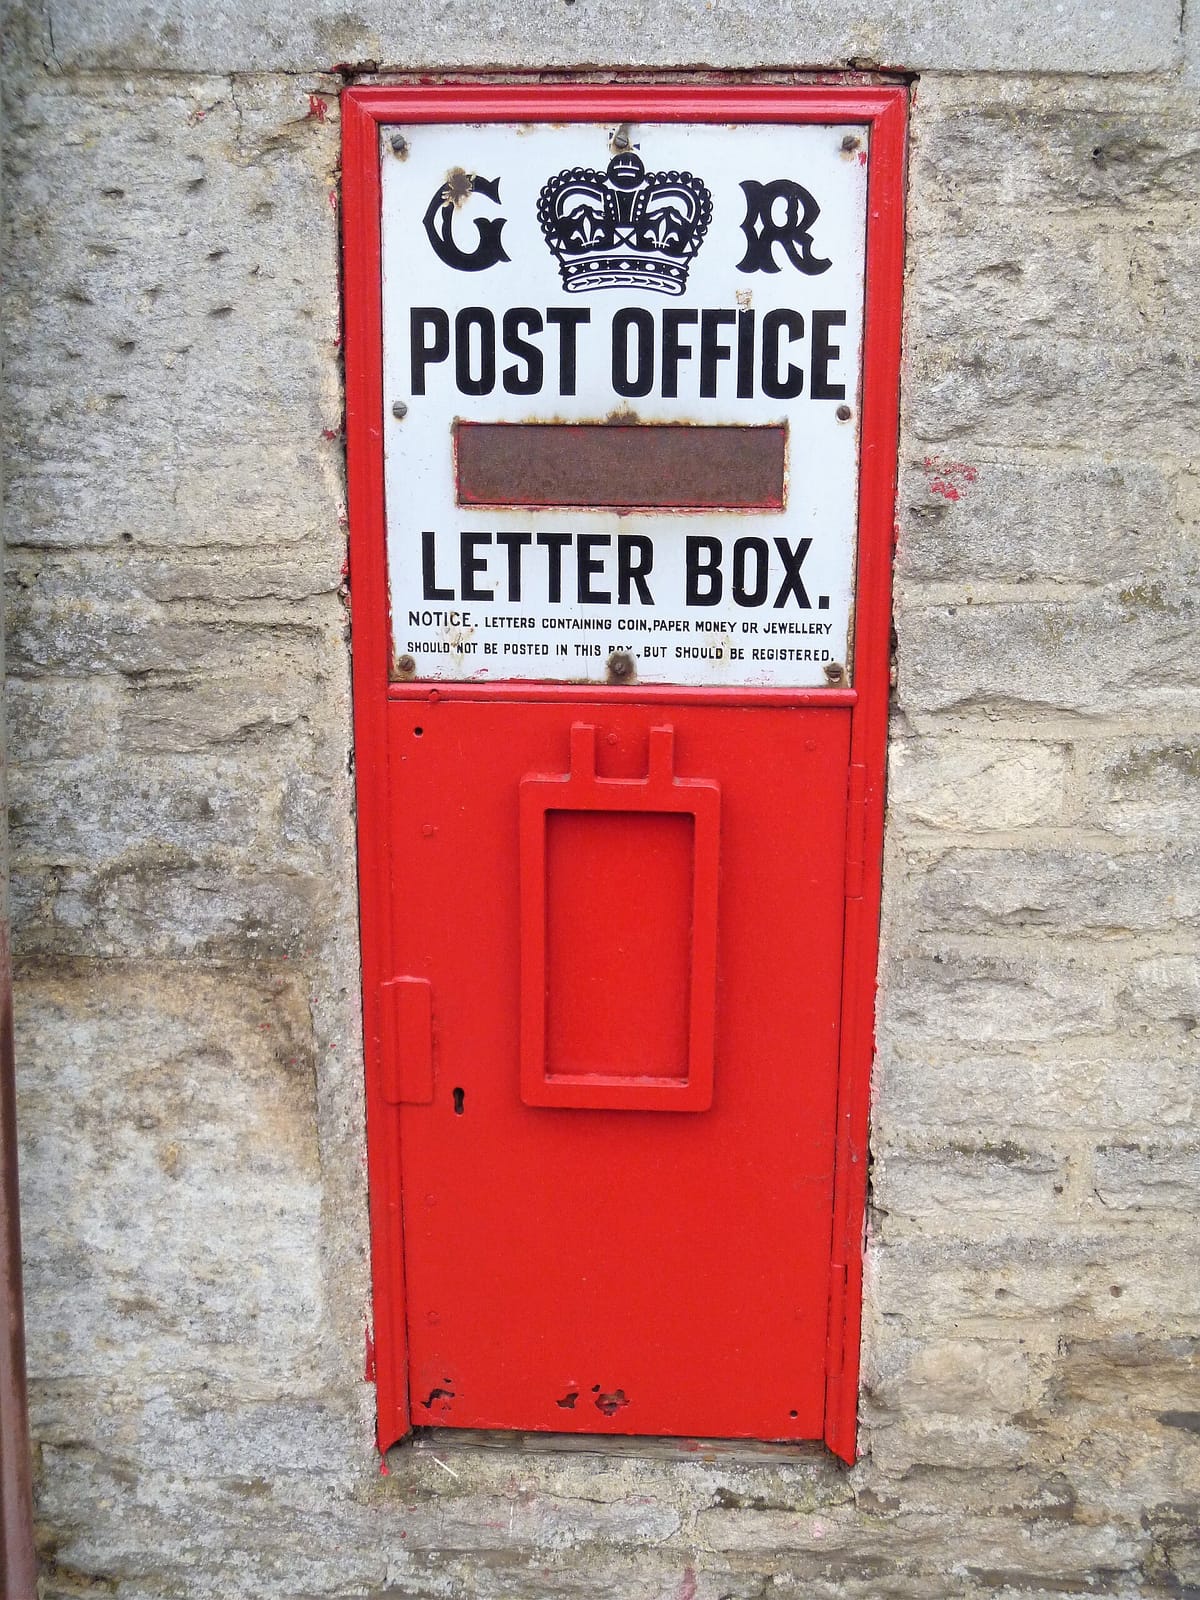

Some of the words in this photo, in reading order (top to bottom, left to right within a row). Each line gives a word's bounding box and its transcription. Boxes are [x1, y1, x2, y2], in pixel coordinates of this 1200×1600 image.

[423, 174, 511, 272] G
[736, 179, 832, 276] R
[411, 307, 590, 396] POST
[611, 308, 847, 400] OFFICE
[422, 532, 655, 605] LETTER
[685, 536, 829, 609] BOX.
[407, 642, 450, 653] SHOULD
[457, 642, 478, 654] NOT
[484, 643, 498, 654] BE
[504, 644, 548, 655] POSTED
[556, 644, 568, 656] IN
[574, 644, 601, 656] THIS
[675, 647, 723, 659] SHOULD
[730, 648, 745, 660] BE
[752, 648, 834, 661] REGISTERED.
[409, 611, 478, 627] NOTICE.
[485, 617, 535, 629] LETTERS
[542, 618, 612, 630] CONTAINING
[695, 621, 737, 633] MONEY
[742, 622, 758, 633] OR
[763, 622, 833, 635] JEWELLERY
